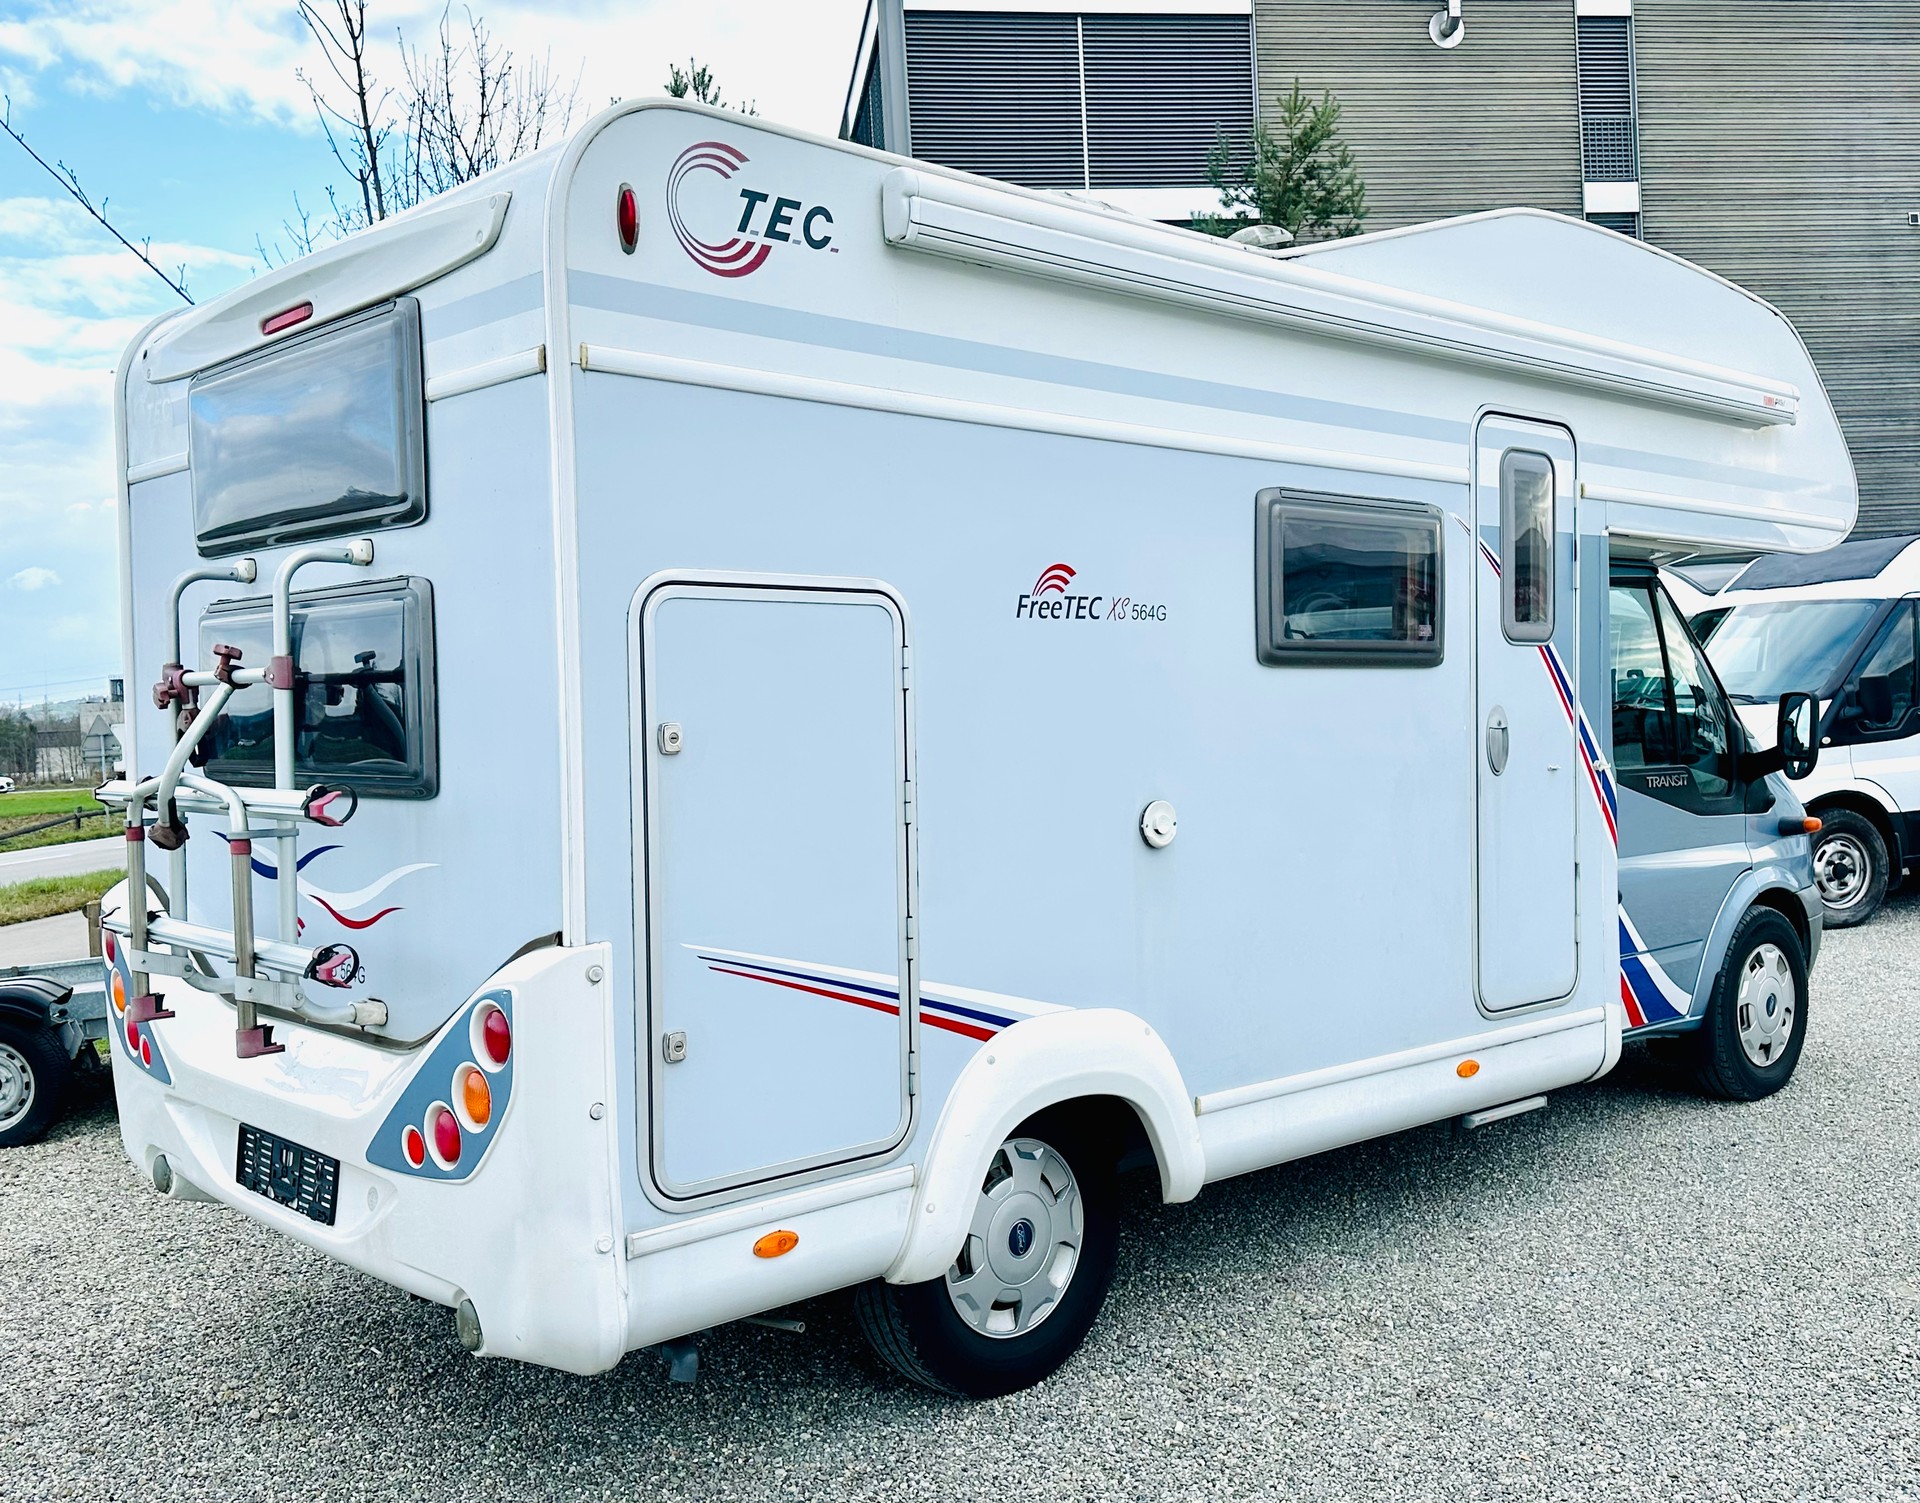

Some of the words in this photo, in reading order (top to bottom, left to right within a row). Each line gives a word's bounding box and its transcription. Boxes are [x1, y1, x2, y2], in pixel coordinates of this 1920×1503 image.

[1016, 594, 1103, 620] FreeTEC
[1106, 597, 1131, 621] XS
[1131, 604, 1167, 621] 564G
[1646, 774, 1688, 788] TRANSIT
[340, 962, 366, 984] 56G
